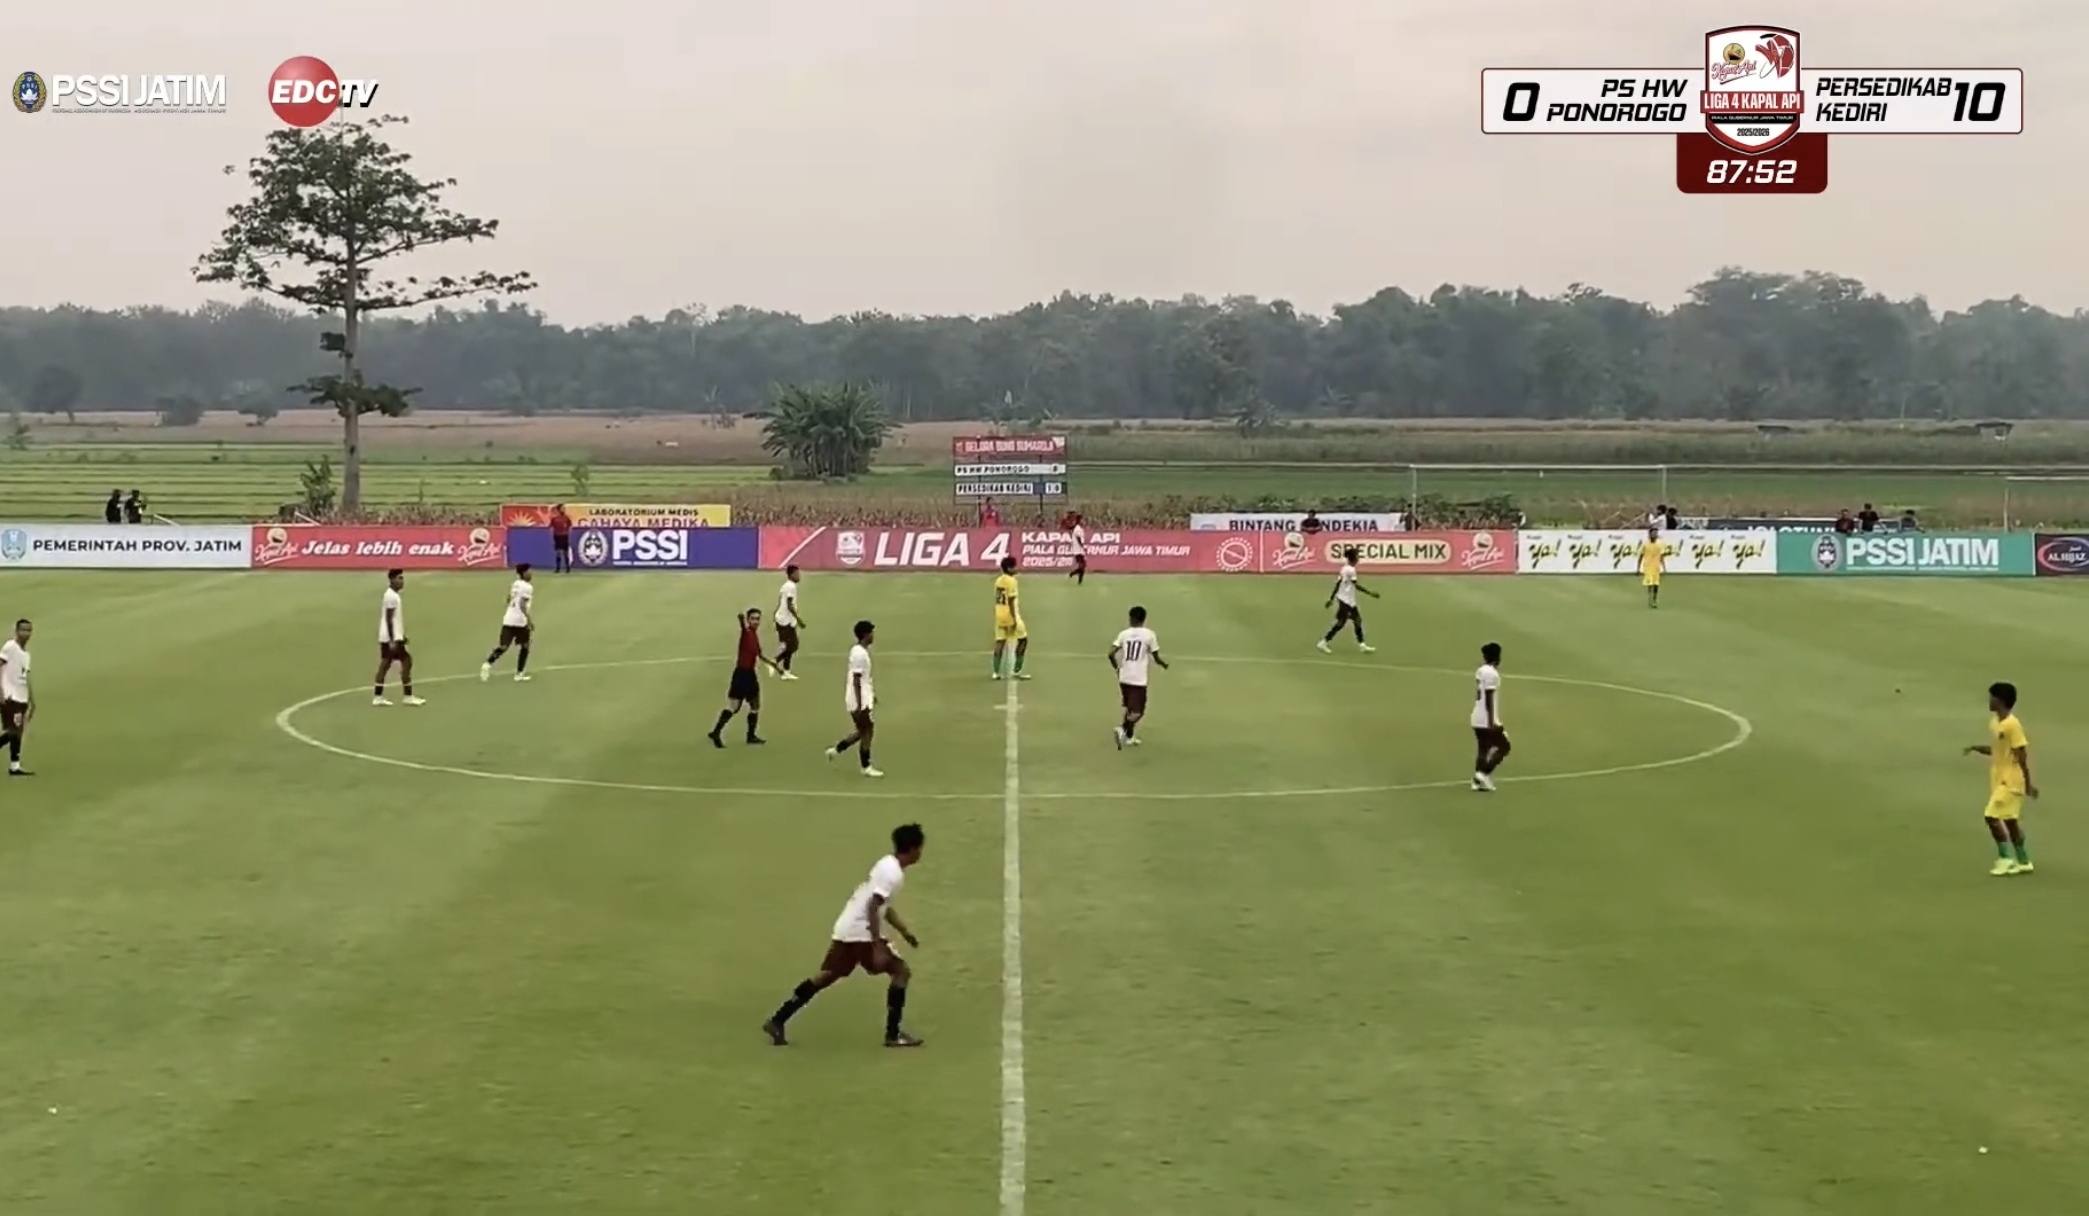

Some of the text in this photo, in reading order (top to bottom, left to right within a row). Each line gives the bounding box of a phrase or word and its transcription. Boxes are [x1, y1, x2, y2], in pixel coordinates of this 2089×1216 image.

[668, 508, 699, 516] MEDIS
[577, 518, 709, 528] CAHAYA MEDIKA
[1229, 520, 1378, 531] BINTANG NDEKIA
[612, 529, 688, 560] PSSI
[1022, 532, 1121, 543] KAPA API
[33, 539, 242, 552] PEMERINTAH PROV. JATIM
[301, 541, 453, 556] Jelas lebih enak
[874, 532, 1010, 567] LIGA 4
[1022, 545, 1055, 555] PIALA
[1121, 545, 1155, 556] JAWA
[1156, 545, 1190, 556] TIMUR
[1415, 543, 1446, 559] MIX
[1846, 537, 1999, 566] PSSI JATIM
[1126, 640, 1142, 661] 10
